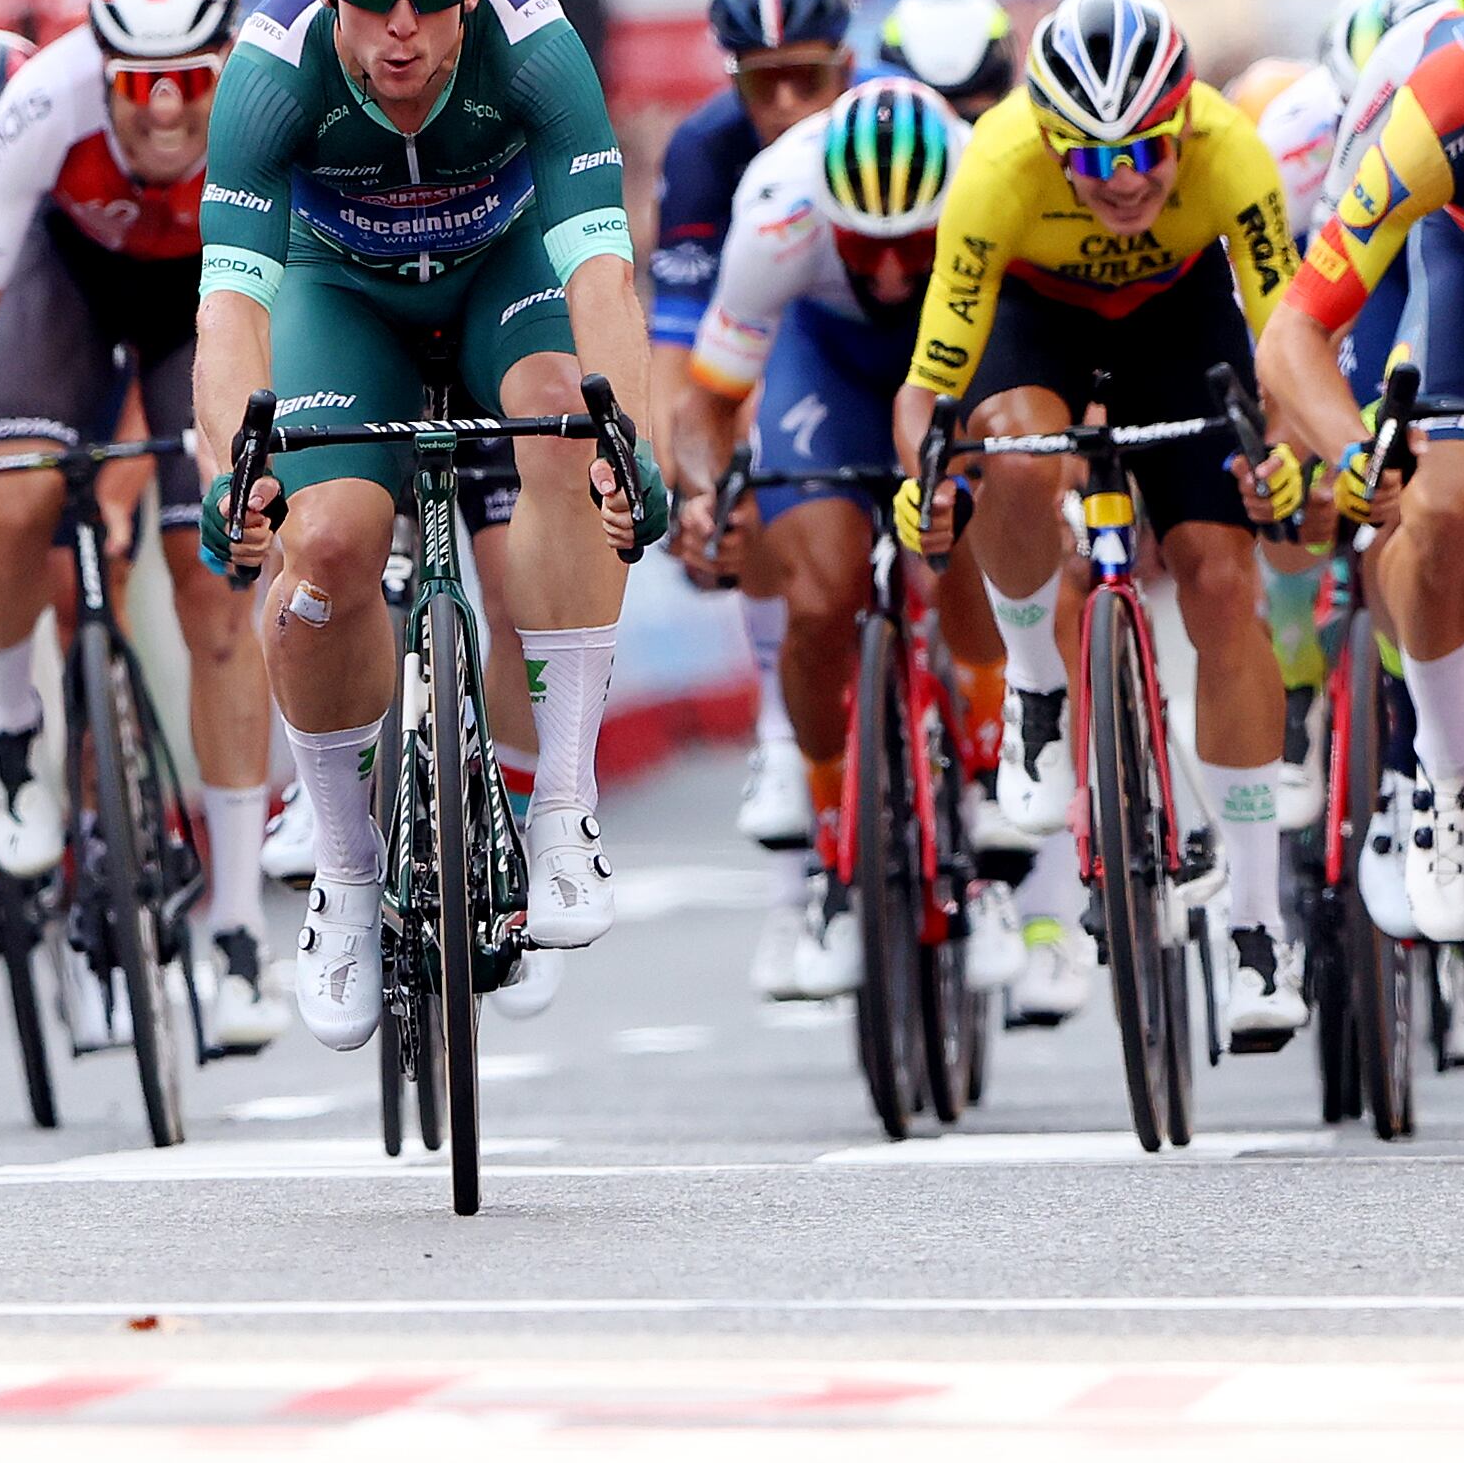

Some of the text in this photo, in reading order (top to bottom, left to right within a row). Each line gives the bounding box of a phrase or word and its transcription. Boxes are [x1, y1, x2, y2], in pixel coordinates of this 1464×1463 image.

[312, 163, 383, 178] Santini
[201, 183, 273, 213] Santini
[339, 192, 502, 237] deceuninck
[383, 227, 466, 244] WINDOWS
[948, 235, 997, 325] ALEA
[418, 440, 455, 449] wahoo
[424, 499, 436, 567] CANYON
[437, 499, 450, 566] CANYON
